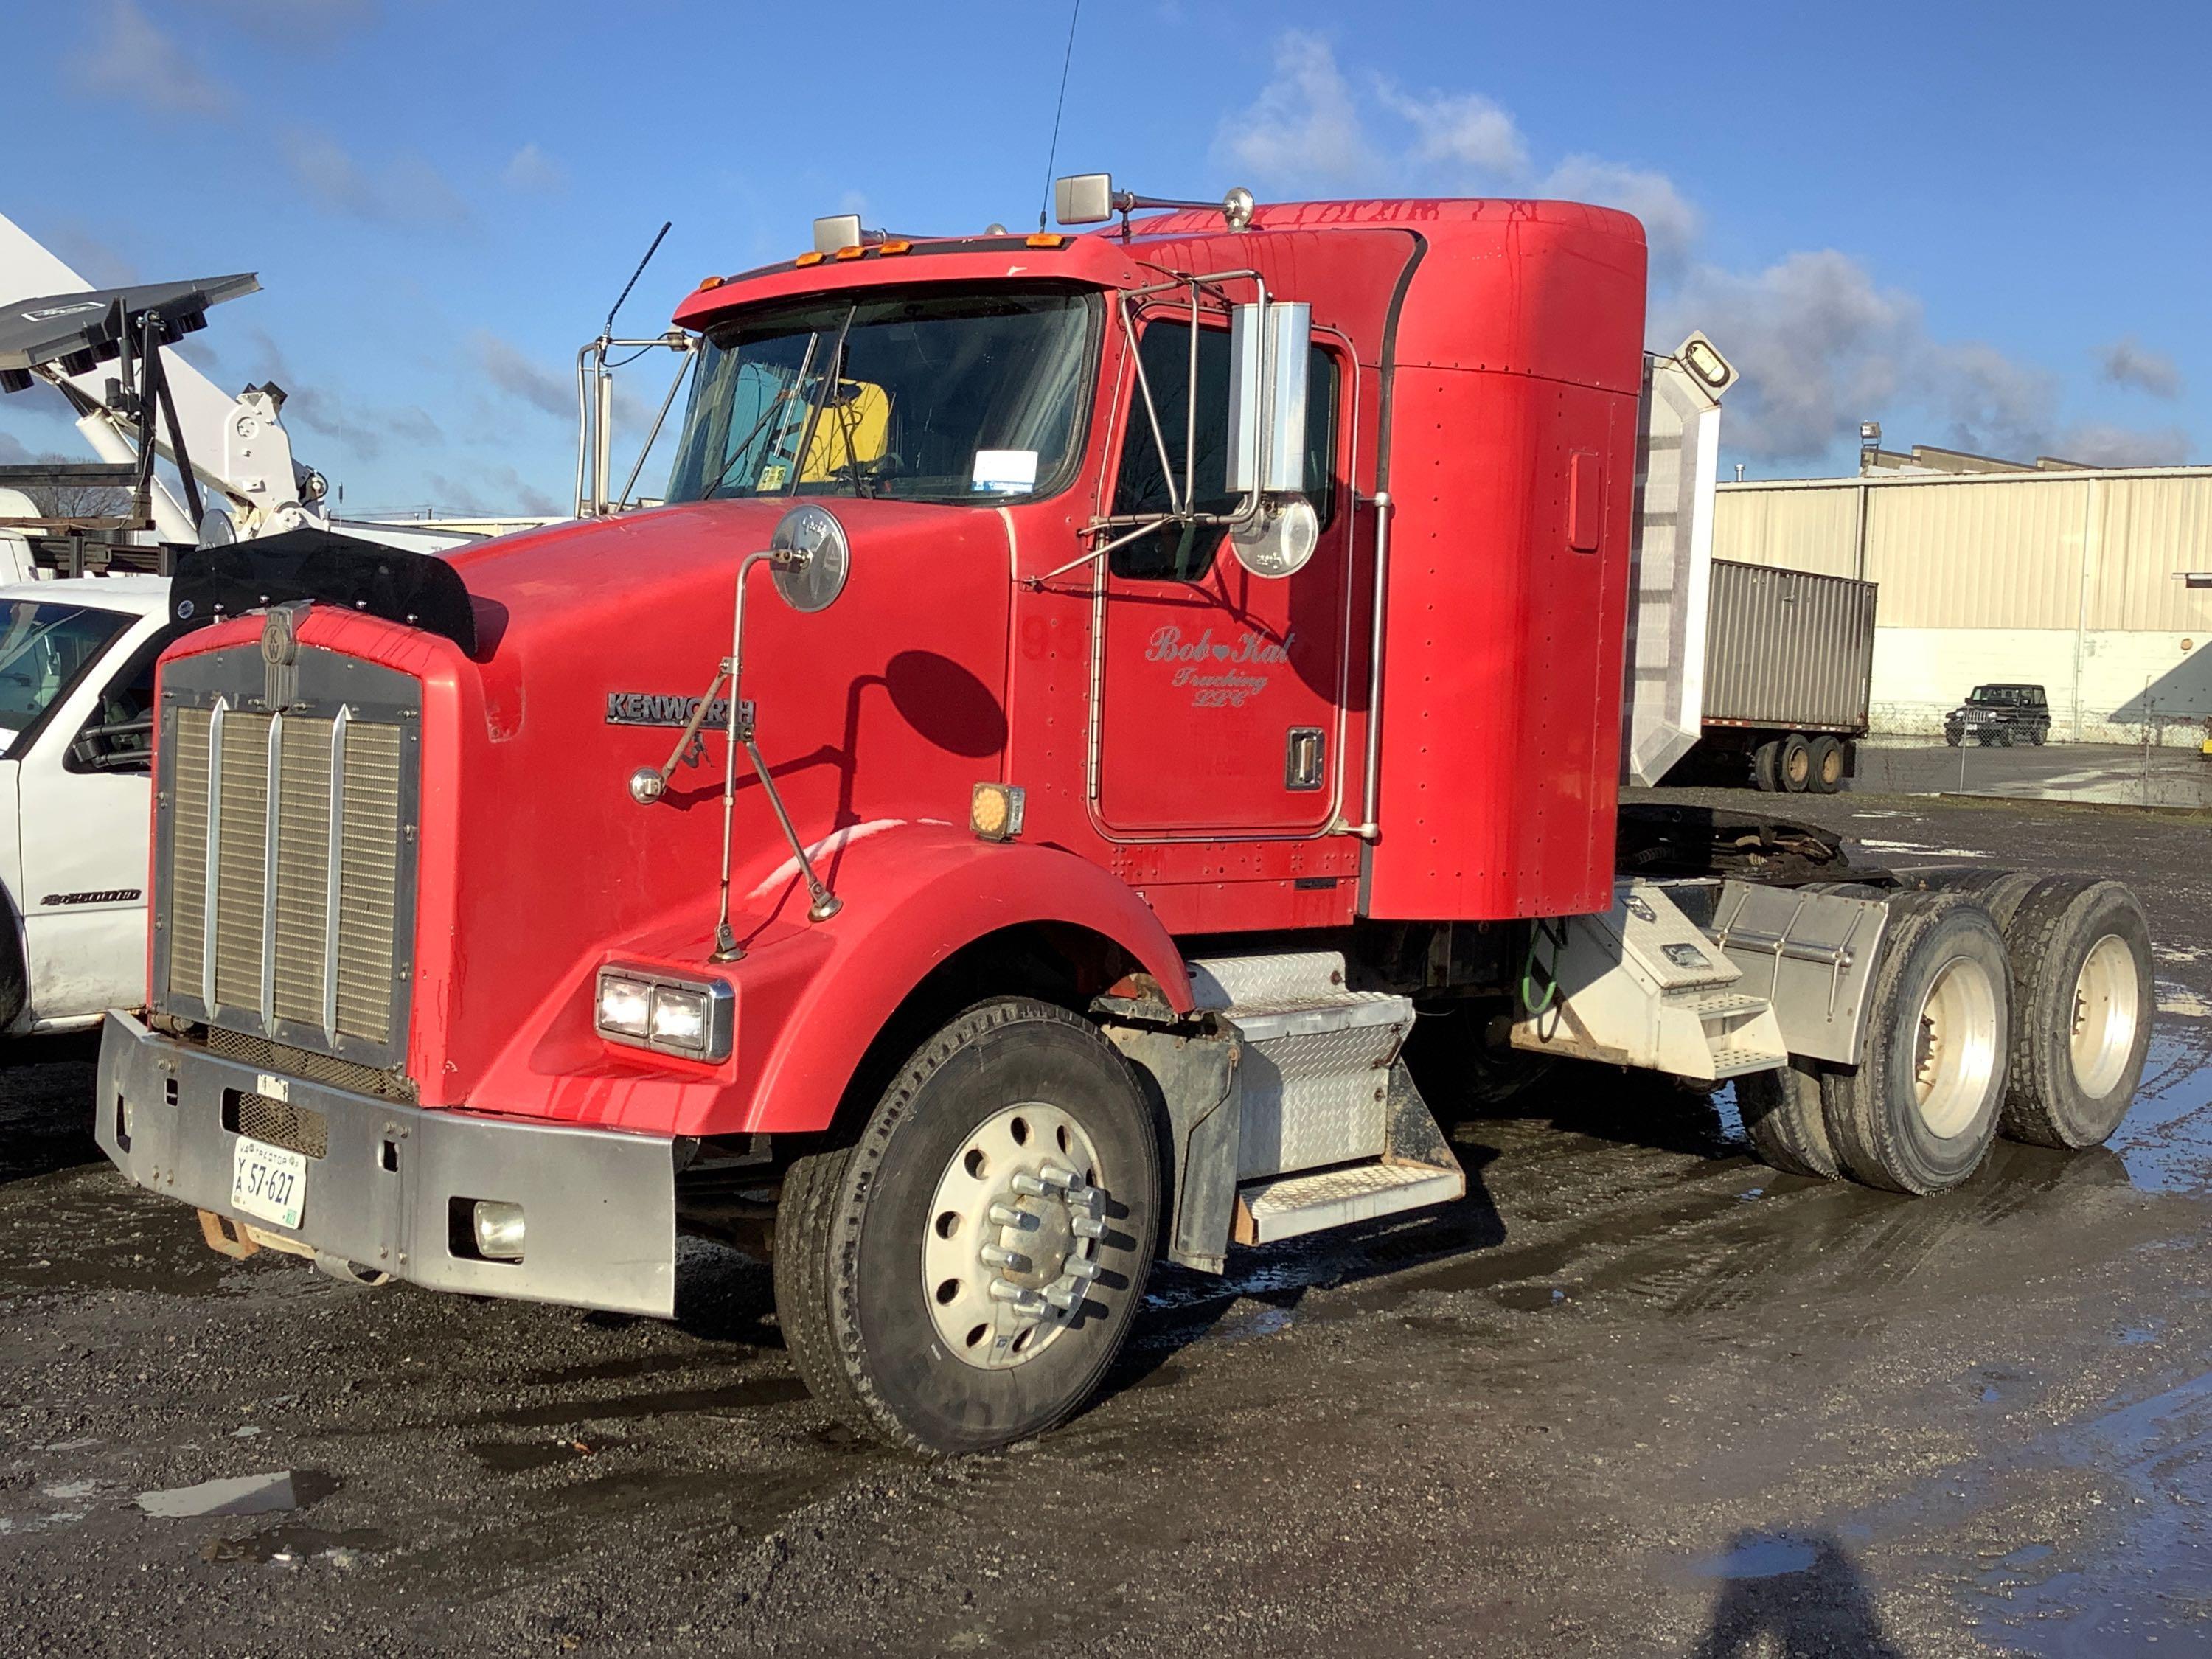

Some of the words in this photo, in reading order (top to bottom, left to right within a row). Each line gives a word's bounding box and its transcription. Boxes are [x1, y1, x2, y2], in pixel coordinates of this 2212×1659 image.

[1145, 625, 1213, 662] Bob
[1231, 629, 1295, 663] Kat
[1172, 667, 1269, 695] Trucking
[1192, 689, 1251, 708] LLC
